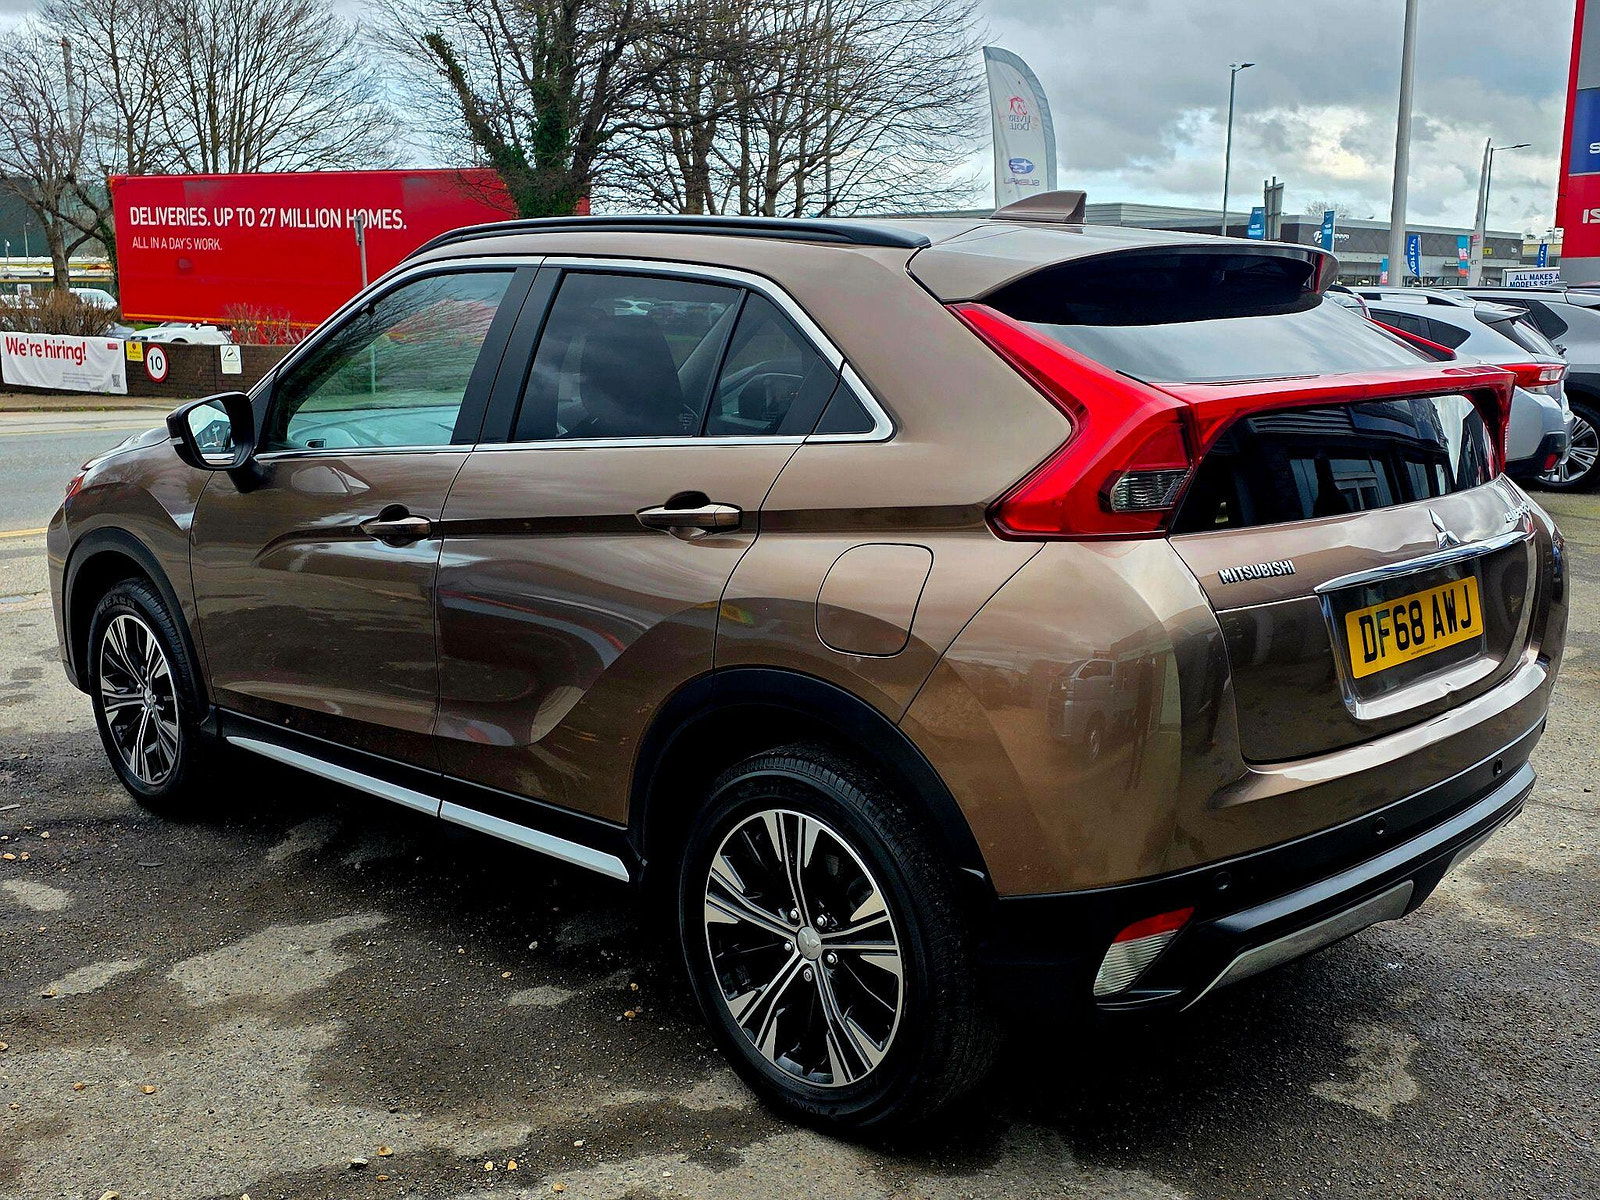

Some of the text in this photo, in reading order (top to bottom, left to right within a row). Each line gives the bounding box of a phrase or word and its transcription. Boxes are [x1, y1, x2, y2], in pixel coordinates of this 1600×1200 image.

[130, 206, 407, 230] DELIVERIES. UP TO 27 MILLION HOMES.
[132, 237, 223, 251] ALL IN A DAY'S WORK.
[1510, 280, 1538, 288] MODELS
[1515, 273, 1527, 281] ALL
[1530, 273, 1553, 281] MAKES
[5, 336, 87, 366] We're hiring!
[149, 355, 163, 371] 10
[1218, 559, 1296, 584] MITSUBISHI
[1359, 585, 1472, 663] DF68 AWJ
